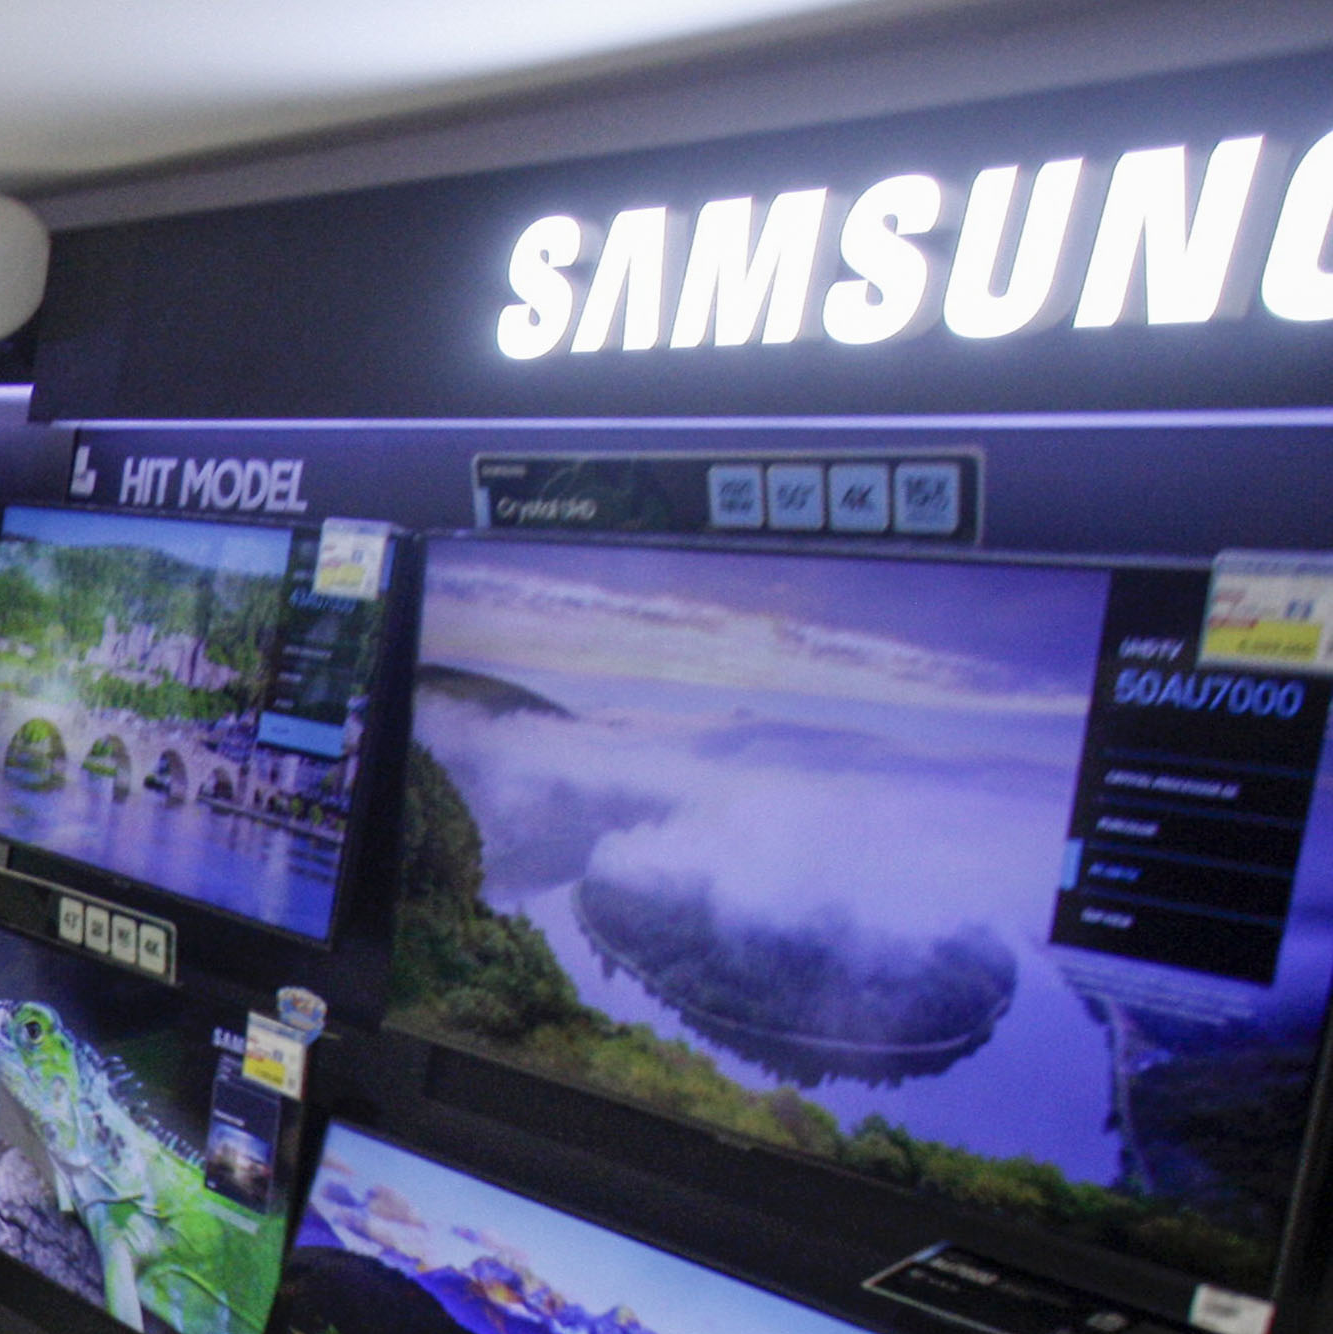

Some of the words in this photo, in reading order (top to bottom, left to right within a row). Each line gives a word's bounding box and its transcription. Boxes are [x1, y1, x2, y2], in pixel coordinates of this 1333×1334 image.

[120, 456, 177, 506] HIT
[178, 457, 308, 514] MODEL
[1114, 671, 1306, 722] 50AU7000
